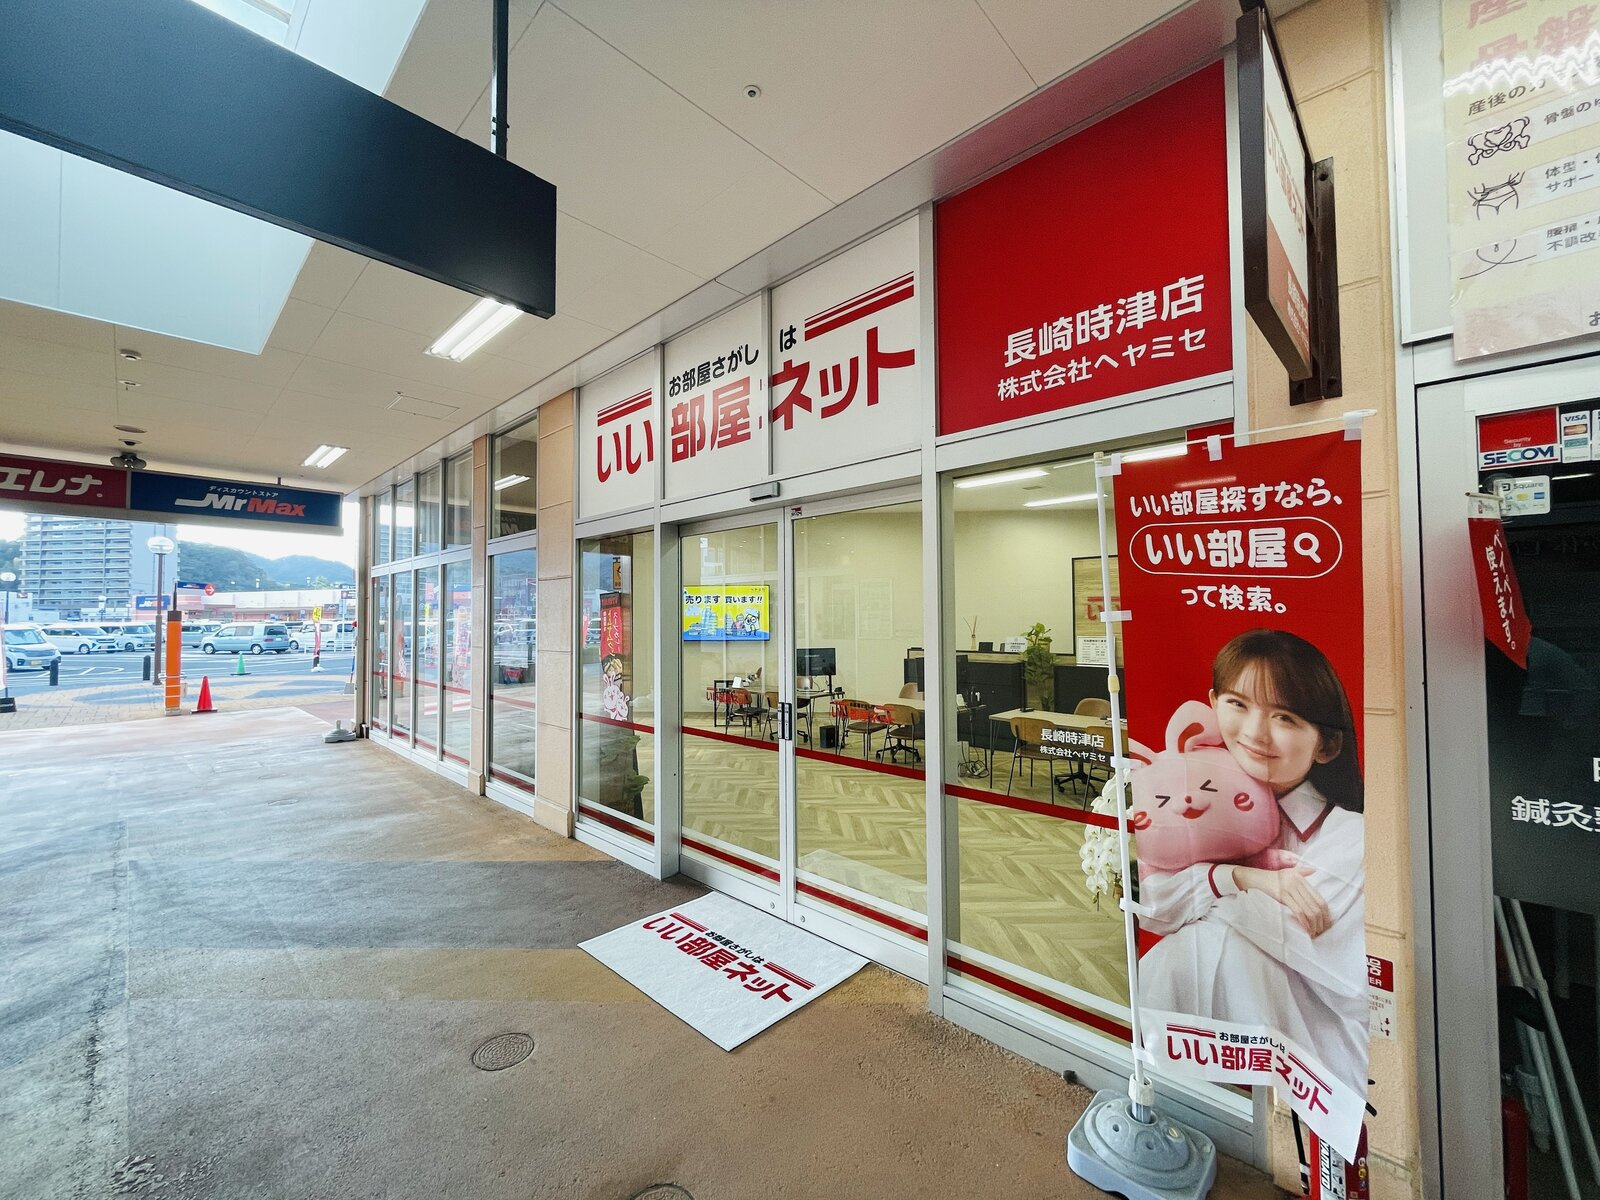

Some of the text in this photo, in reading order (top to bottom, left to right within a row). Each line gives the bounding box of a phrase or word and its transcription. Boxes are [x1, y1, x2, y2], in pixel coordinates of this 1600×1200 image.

[1546, 231, 1600, 251] 不調改
[1004, 274, 1205, 368] 長崎時津店
[997, 328, 1207, 401] 株式会社ヘヤミセ
[1564, 414, 1587, 422] VISA
[1483, 445, 1555, 466] SECOM
[0, 466, 103, 497] エレナ
[208, 485, 279, 498] ディスカウントストア
[1130, 478, 1343, 518] いい部屋探すなら、
[1145, 527, 1288, 569] いい部屋
[685, 595, 720, 604] 売ります
[1181, 584, 1287, 613] って検索。
[1041, 728, 1105, 749] 長崎時津店
[1040, 745, 1106, 763] 株式会社ヘヤミセ
[1511, 795, 1600, 832] 鍼灸
[642, 916, 793, 1003] いい部屋ネット
